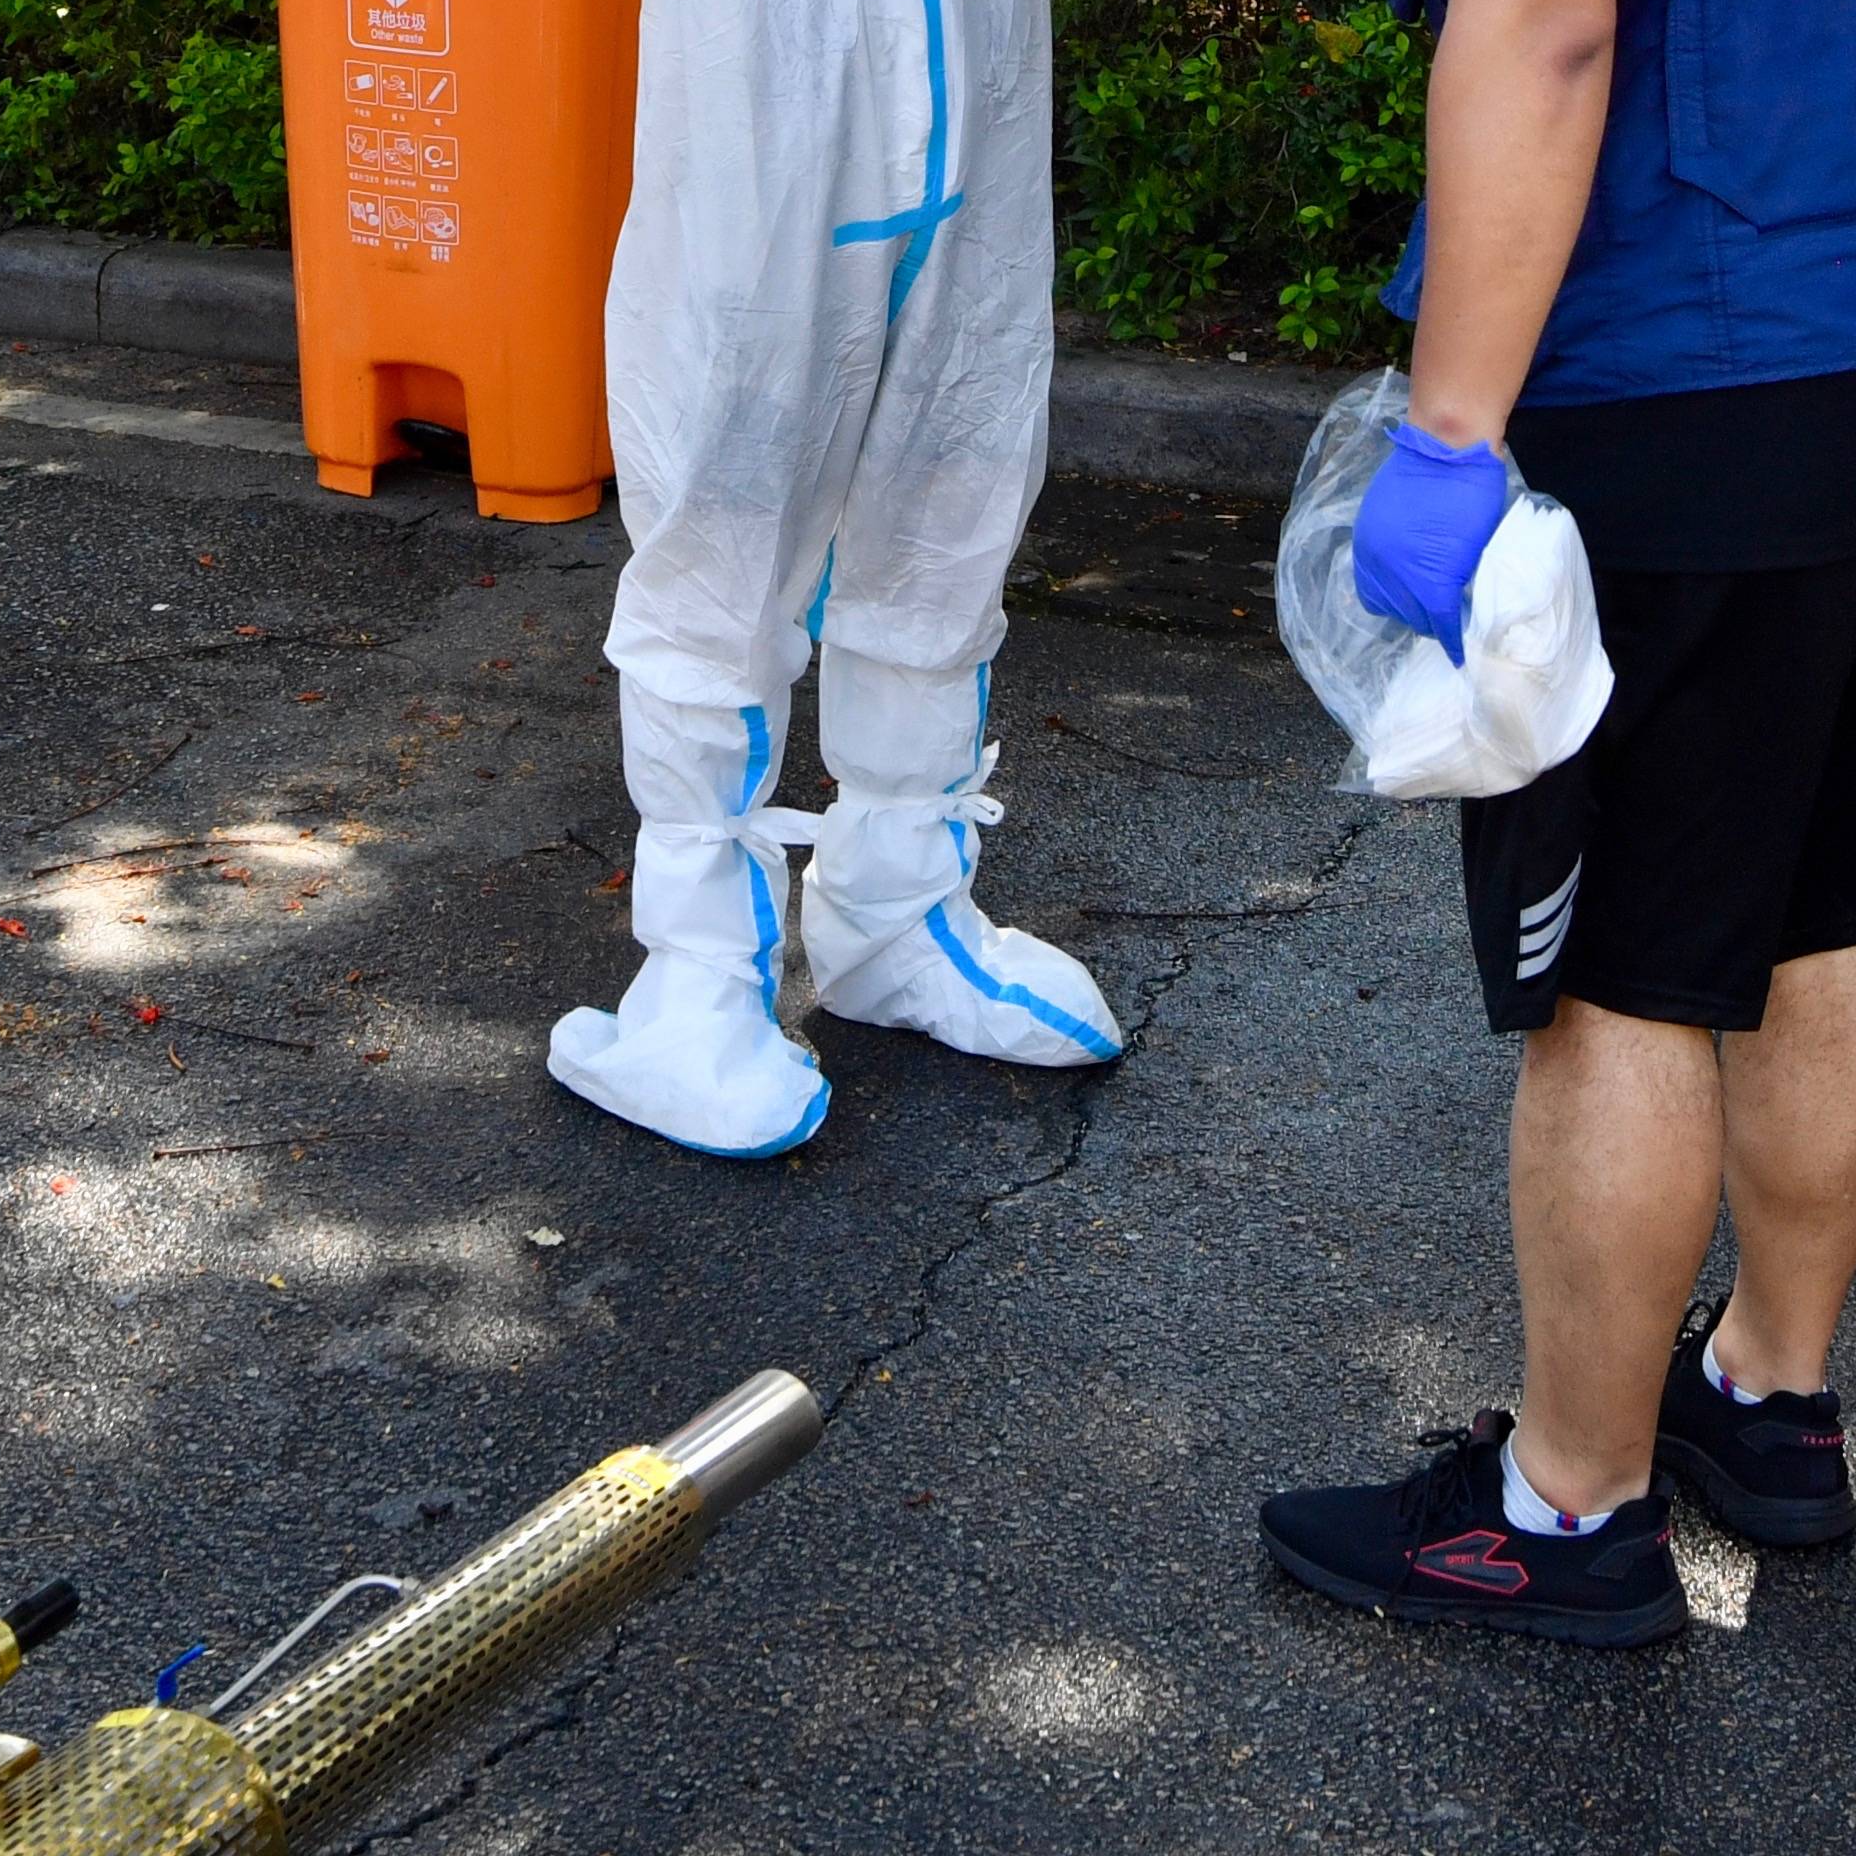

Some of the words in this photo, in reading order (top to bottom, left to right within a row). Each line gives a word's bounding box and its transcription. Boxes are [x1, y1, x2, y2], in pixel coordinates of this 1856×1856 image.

[367, 8, 427, 32] 其他垃圾
[370, 28, 395, 41] Other
